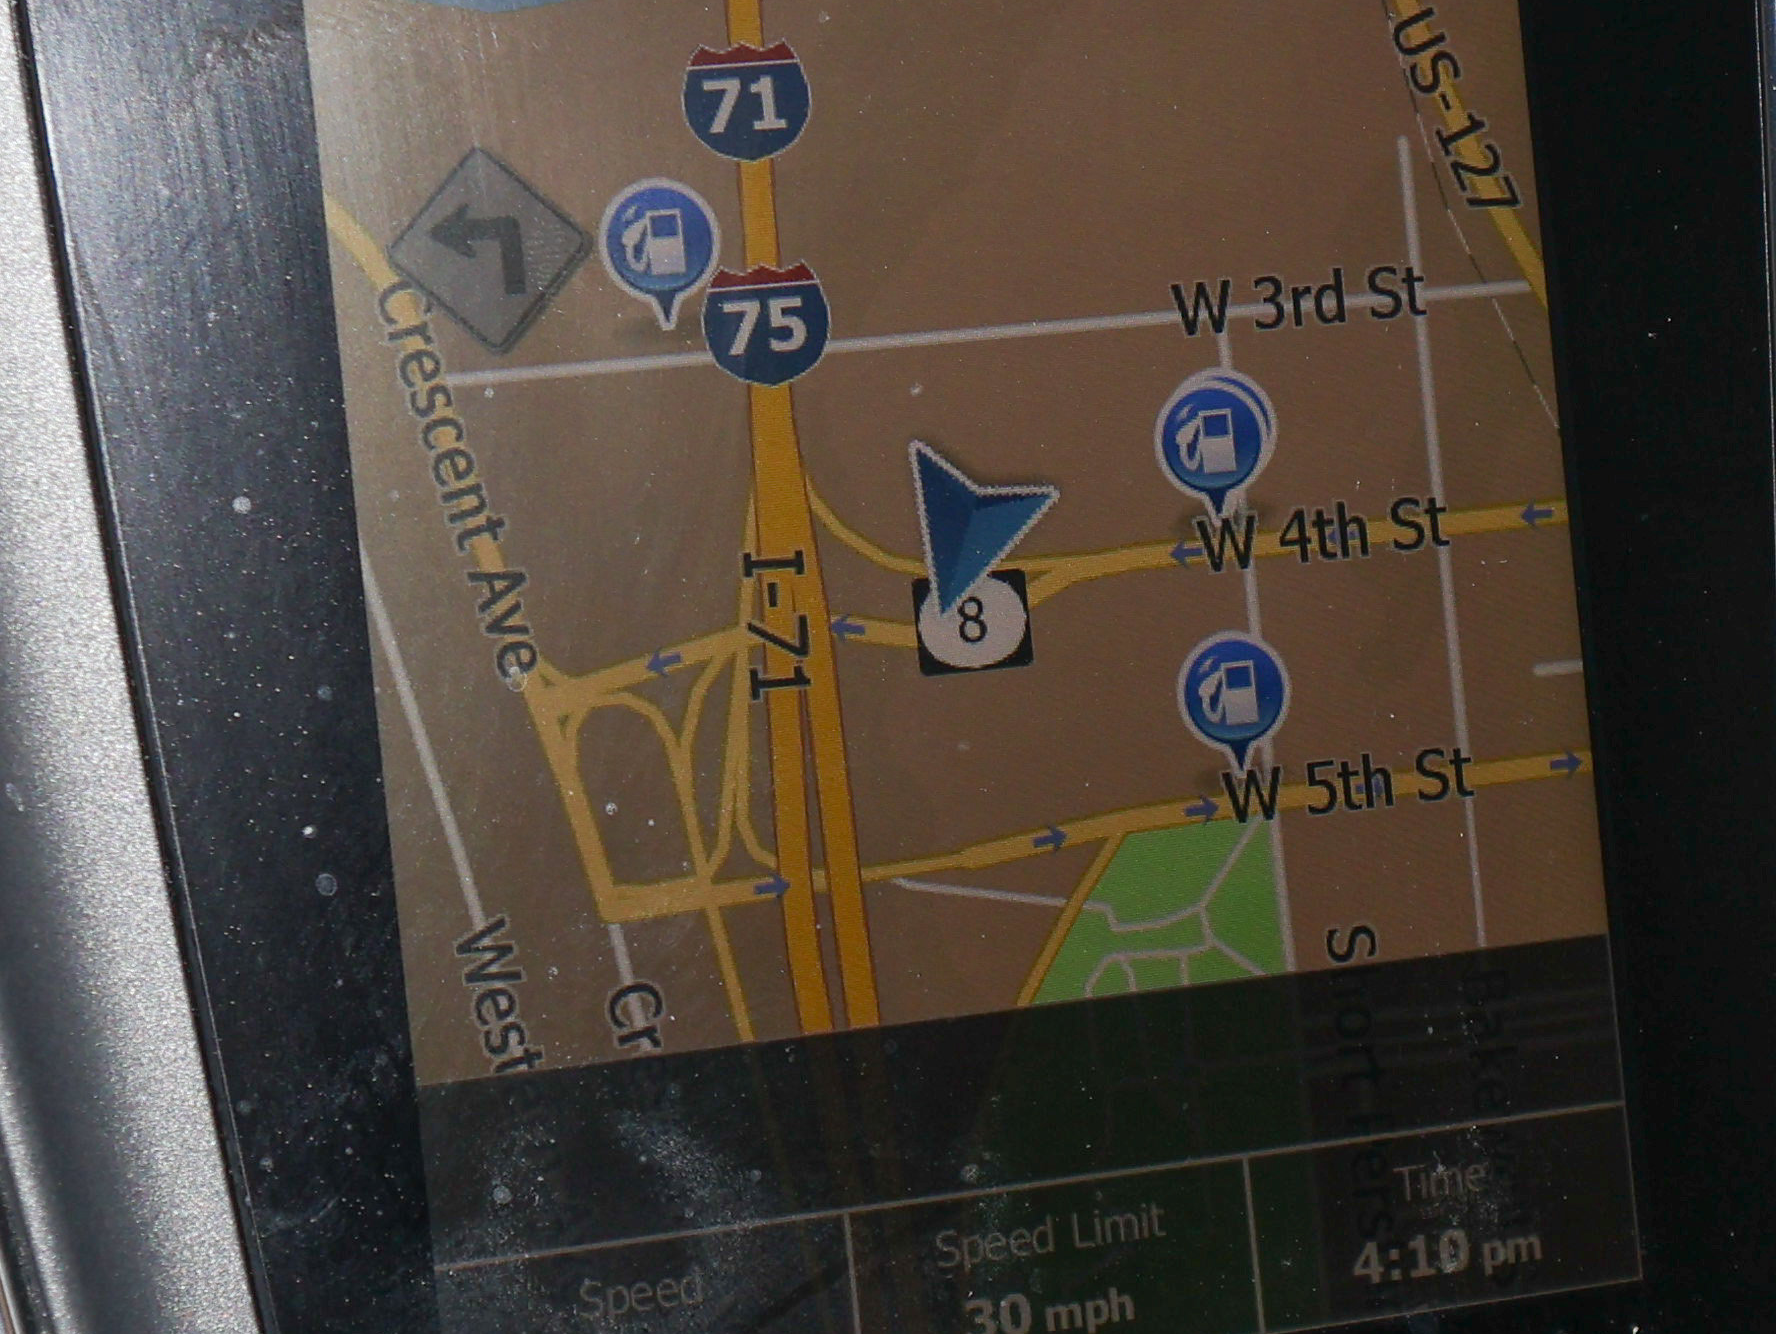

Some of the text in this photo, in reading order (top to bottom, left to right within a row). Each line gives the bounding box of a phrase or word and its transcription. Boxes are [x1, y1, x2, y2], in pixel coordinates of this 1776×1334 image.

[701, 74, 789, 134] 71
[1392, 6, 1522, 209] US-127
[722, 295, 809, 356] 75
[1170, 265, 1428, 337] W 3rd St
[378, 279, 539, 684] Crescent Ave
[1195, 496, 1451, 573] W 4th St
[742, 549, 812, 701] I-71
[957, 595, 988, 644] 8
[1221, 746, 1475, 824] W 5th St
[1392, 1164, 1490, 1203] Time
[936, 1203, 1168, 1272] Speed Limit
[1352, 1229, 1472, 1286] 4:10
[1481, 1234, 1544, 1278] pm
[578, 1265, 704, 1330] Speed
